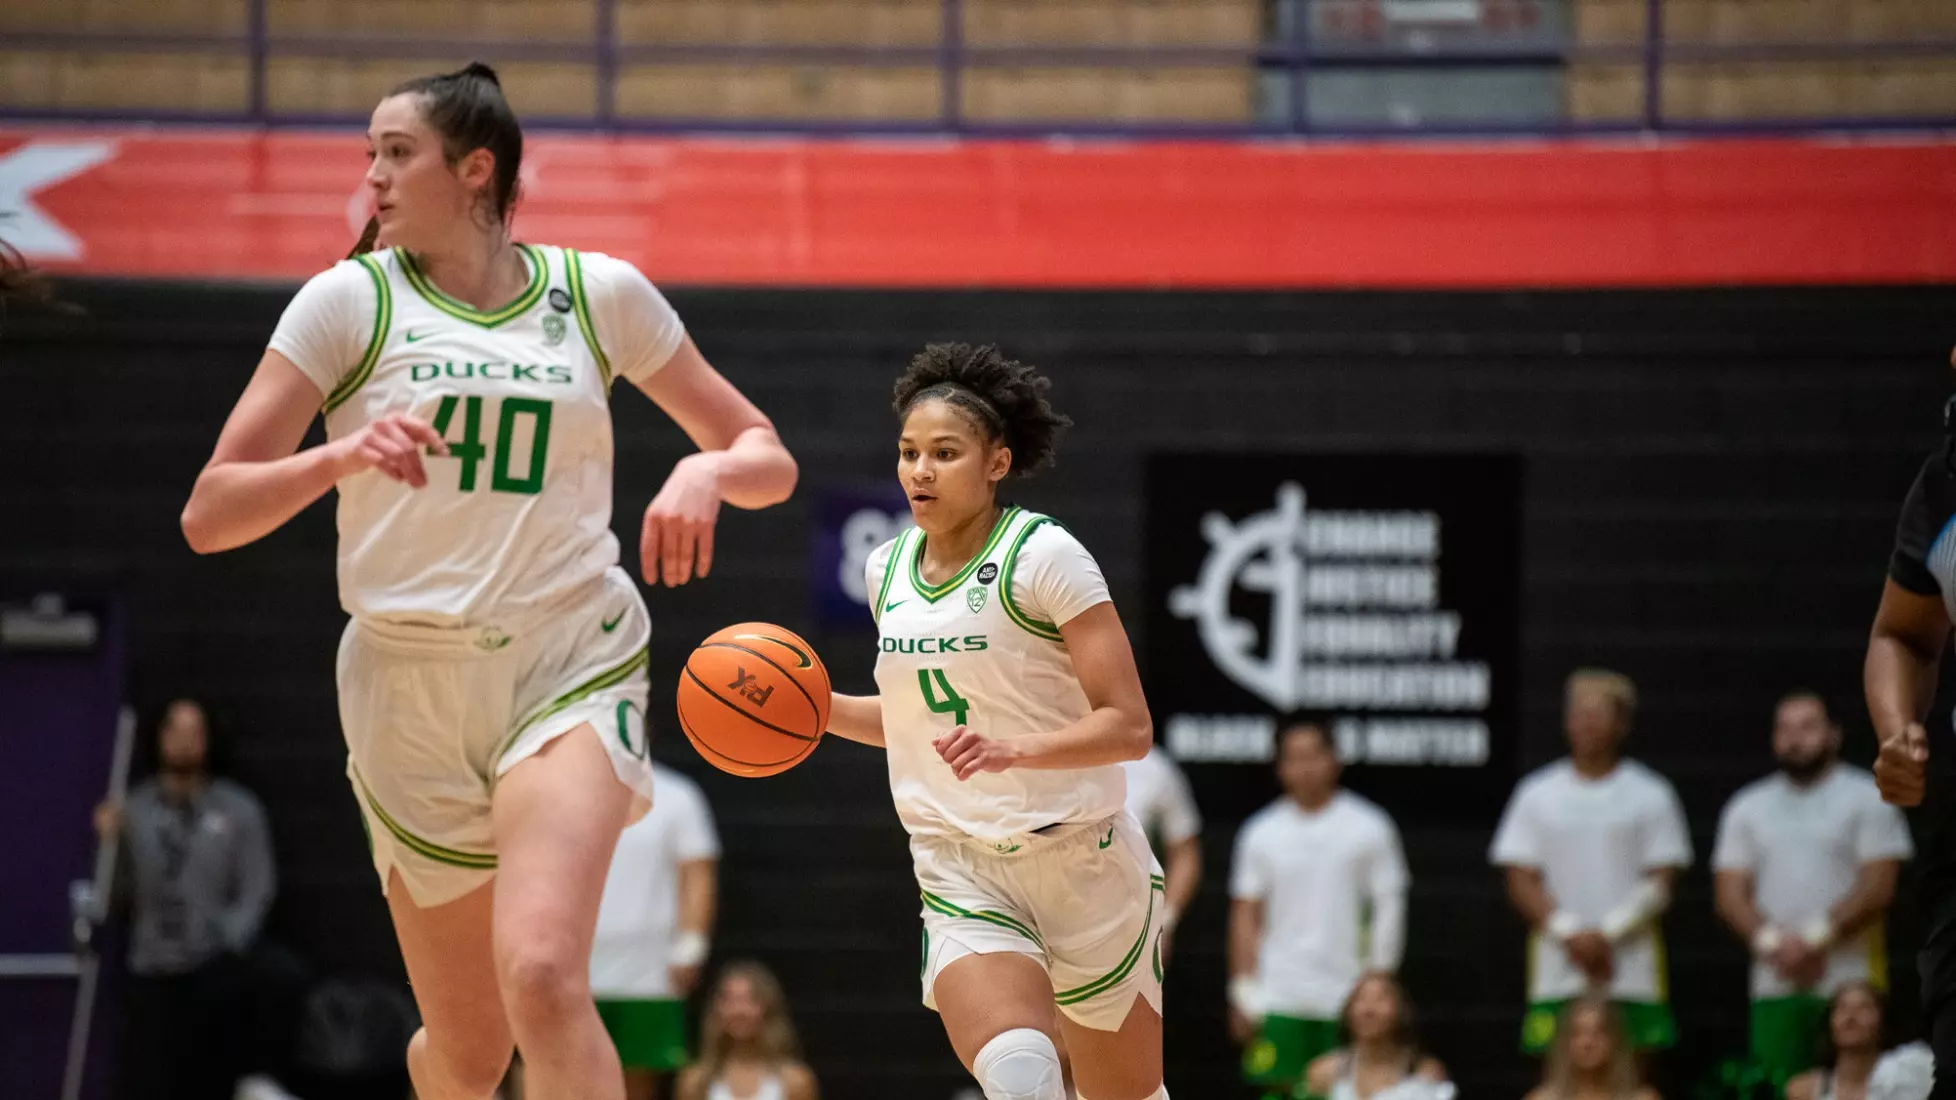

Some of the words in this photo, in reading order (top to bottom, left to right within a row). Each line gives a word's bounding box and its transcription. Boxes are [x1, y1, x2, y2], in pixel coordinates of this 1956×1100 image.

[411, 362, 573, 384] DUCKS
[426, 395, 553, 495] 40
[882, 635, 988, 654] DUCKS
[917, 668, 970, 727] 4
